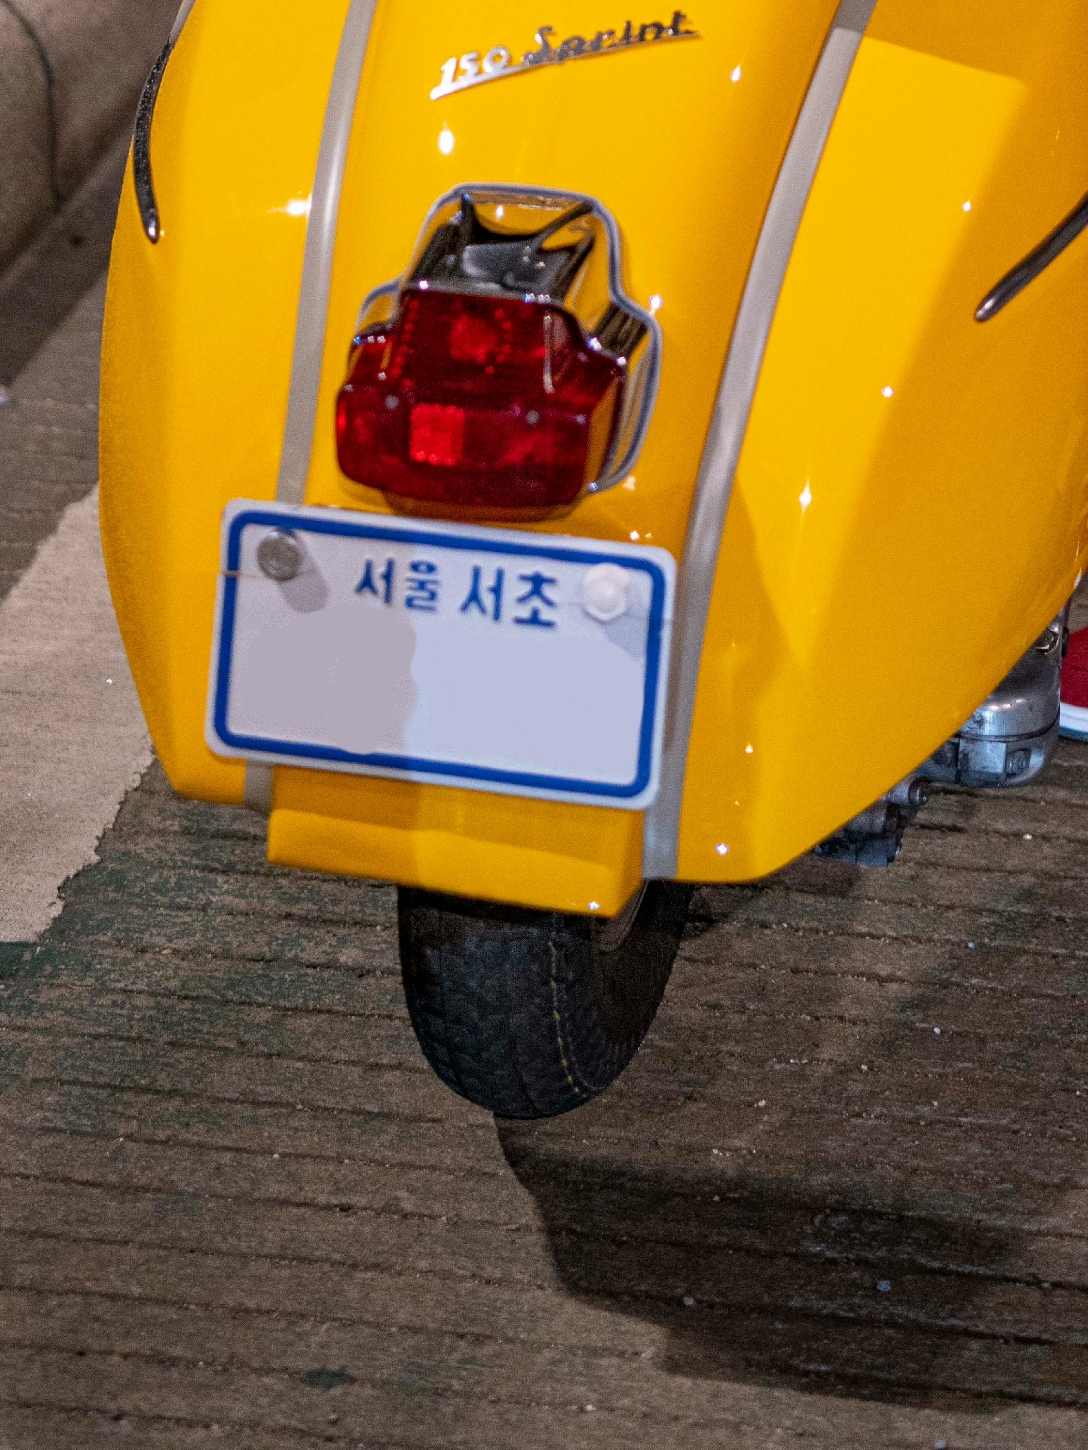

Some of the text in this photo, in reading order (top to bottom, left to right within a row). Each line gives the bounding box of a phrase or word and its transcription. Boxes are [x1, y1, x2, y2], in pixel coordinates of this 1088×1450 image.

[433, 46, 510, 96] 150
[355, 557, 559, 630] 서울 서초
